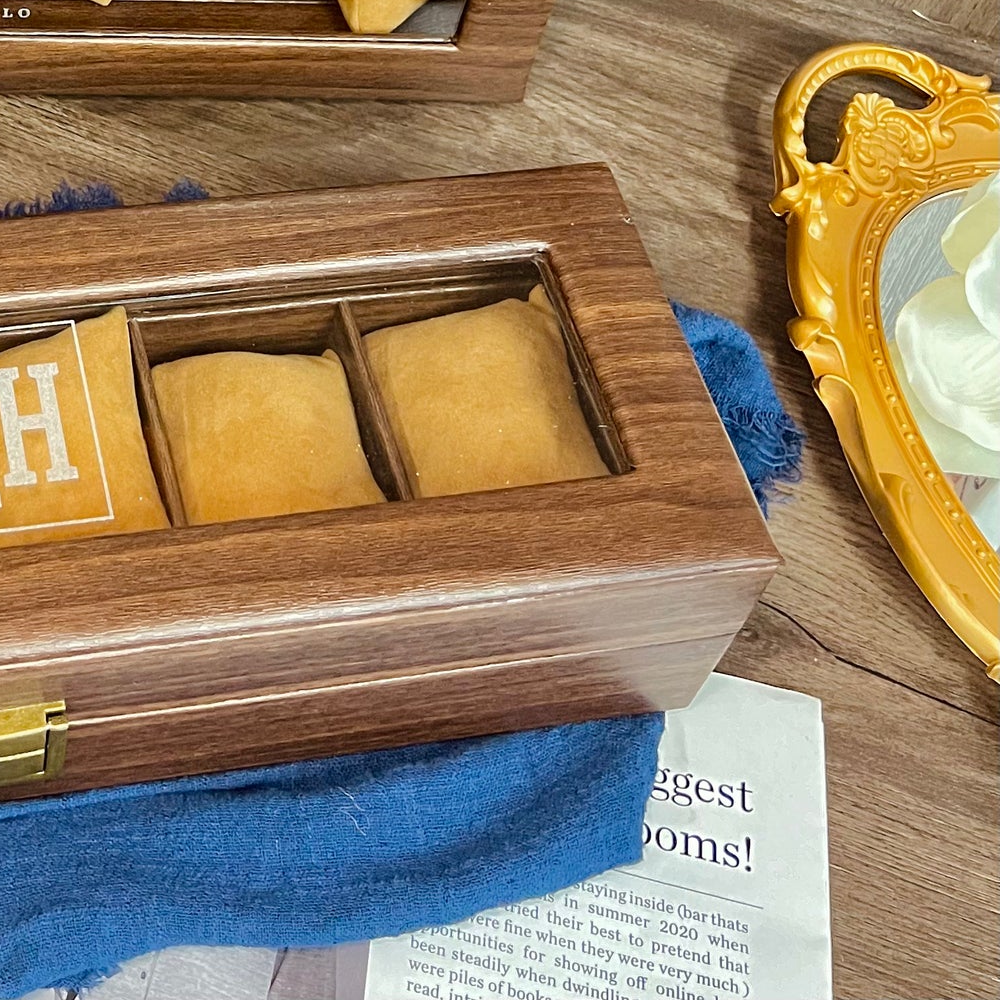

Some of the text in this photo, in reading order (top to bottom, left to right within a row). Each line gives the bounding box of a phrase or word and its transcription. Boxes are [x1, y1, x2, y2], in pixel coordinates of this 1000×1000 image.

[2, 8, 31, 18] LO
[564, 893, 579, 910] in
[588, 902, 650, 929] summer
[659, 920, 698, 941] 2020
[708, 934, 749, 954] when
[629, 890, 674, 914] inside
[677, 903, 708, 923] (bar
[711, 913, 749, 934] thats
[410, 935, 446, 957] been
[451, 950, 511, 977] steadily
[516, 966, 557, 987] when
[504, 919, 532, 938] fine
[535, 930, 576, 951] when
[581, 940, 614, 963] they
[618, 953, 655, 971] were
[659, 963, 692, 984] very
[547, 910, 584, 931] their
[590, 920, 622, 942] best
[628, 932, 644, 948] to
[651, 941, 711, 966] pretend
[719, 955, 750, 975] that
[409, 959, 445, 978] were
[448, 969, 484, 989] piles
[488, 980, 505, 994] of
[523, 945, 546, 963] for
[554, 955, 618, 986] showing
[626, 975, 648, 991] off
